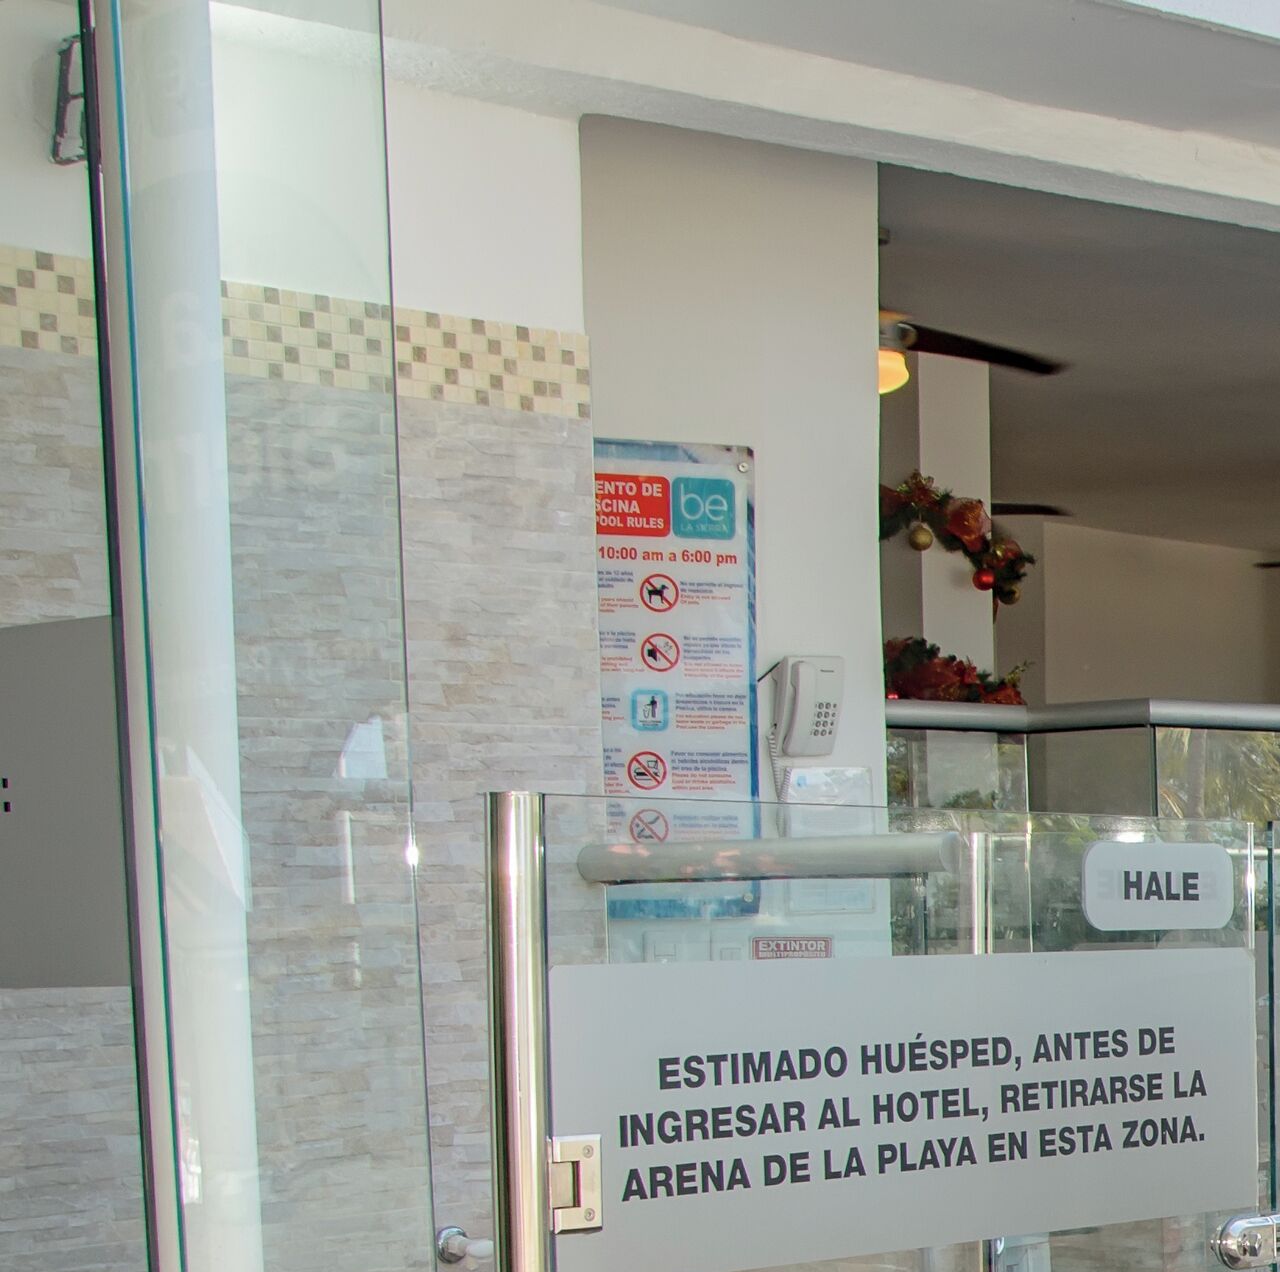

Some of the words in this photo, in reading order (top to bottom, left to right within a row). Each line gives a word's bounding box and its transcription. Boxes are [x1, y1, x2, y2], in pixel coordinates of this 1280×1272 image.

[641, 482, 662, 497] DE
[680, 483, 728, 521] be
[626, 516, 664, 529] RULES
[598, 546, 637, 560] 10:00
[643, 550, 663, 561] am
[669, 552, 676, 562] a
[682, 549, 711, 563] 6:00
[716, 554, 737, 567] pm
[1124, 871, 1199, 901] HALE
[758, 939, 826, 951] EXTINTOR
[659, 1047, 847, 1089] ESTIMADO
[861, 1034, 1021, 1074] HUÉSPED,
[1033, 1029, 1128, 1063] ANTES
[1139, 1027, 1174, 1055] DE
[620, 1101, 805, 1147] INGRESAR
[818, 1097, 860, 1129] AL
[873, 1088, 989, 1124] HOTEL,
[1001, 1073, 1163, 1113] RETIRARSE
[1174, 1070, 1207, 1098] LA
[622, 1159, 750, 1201] ARENA
[764, 1152, 810, 1186] DE
[824, 1147, 866, 1179] LA
[878, 1136, 977, 1174] PLAYA
[988, 1131, 1027, 1162] EN
[1040, 1124, 1112, 1157] ESTA
[1123, 1116, 1205, 1148] ZONA.
